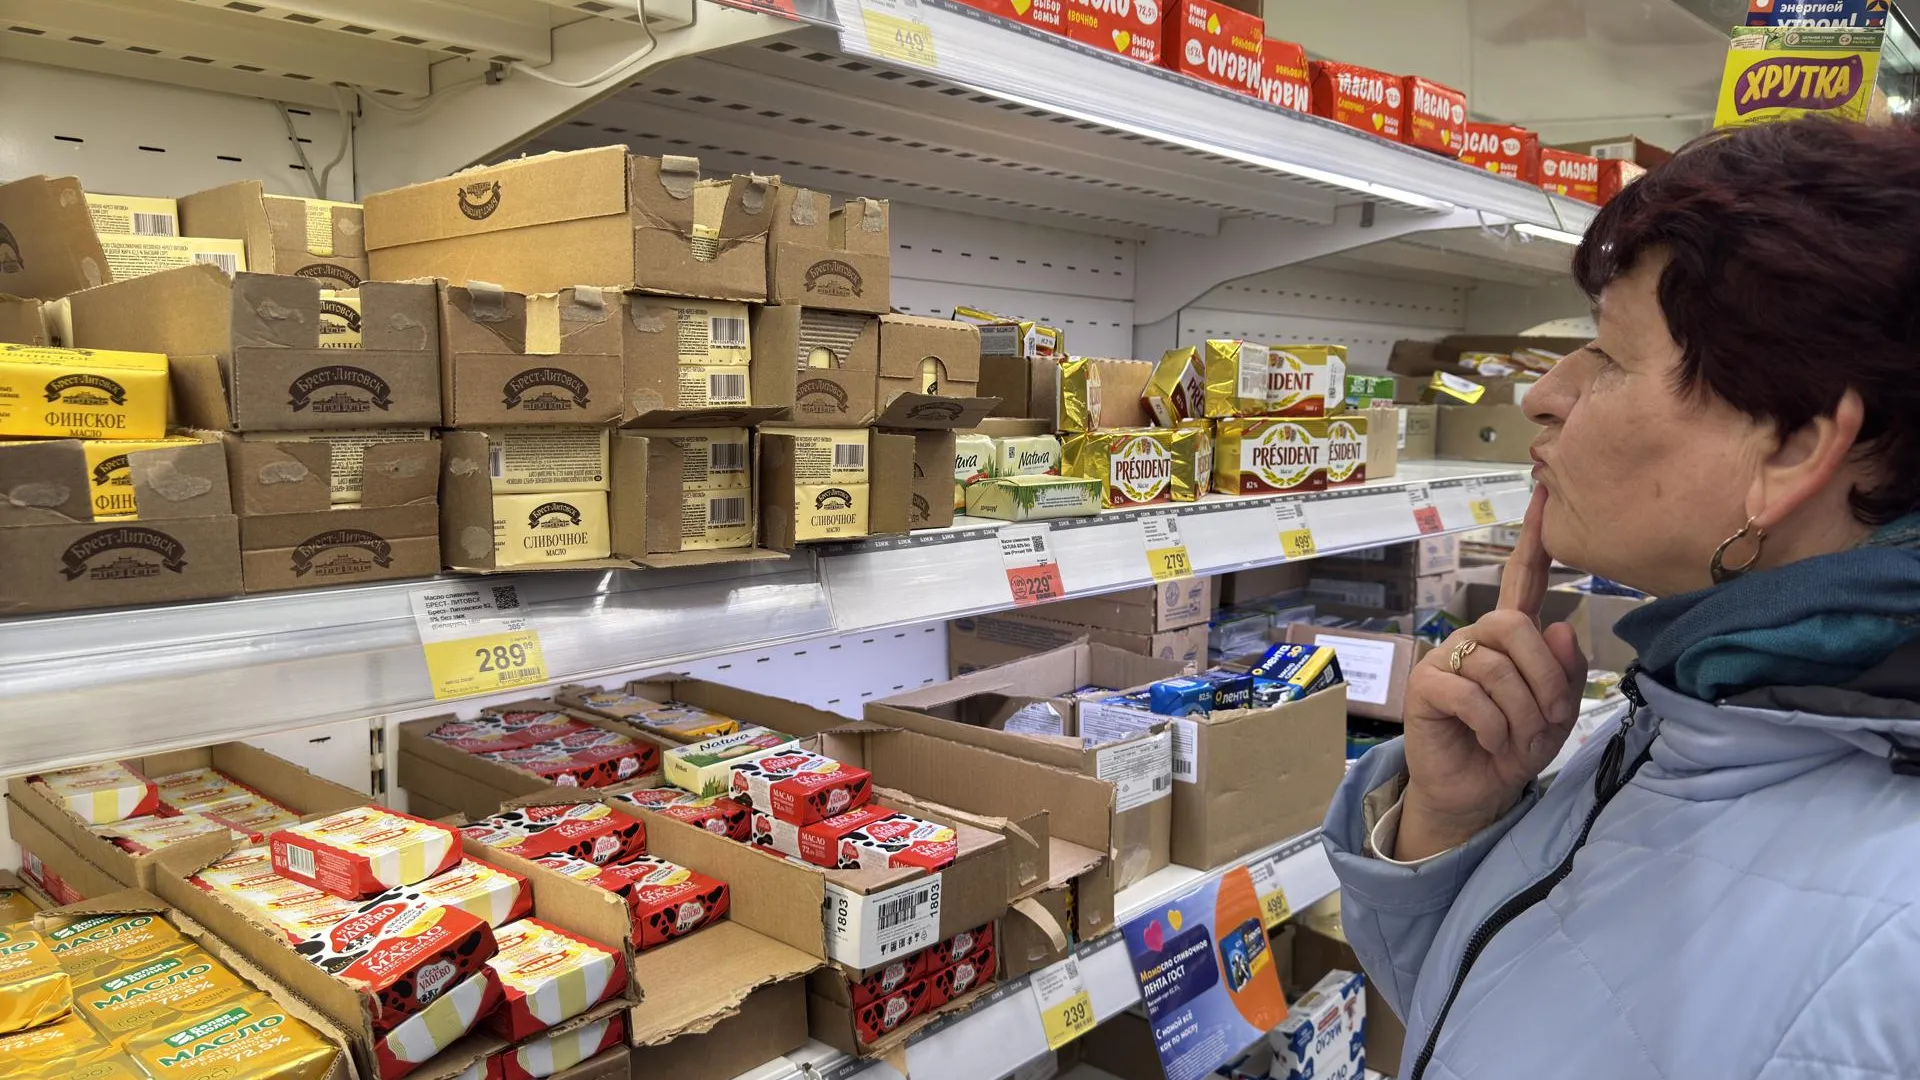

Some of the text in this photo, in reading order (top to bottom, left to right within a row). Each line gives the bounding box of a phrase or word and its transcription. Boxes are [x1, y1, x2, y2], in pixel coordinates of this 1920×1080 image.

[1780, 1, 1844, 19] энергией
[896, 28, 924, 52] 449
[1208, 46, 1261, 89] Масло
[1261, 77, 1309, 113] Масл
[1741, 64, 1850, 105] ХРУТКА
[1414, 87, 1450, 121] Масло
[799, 380, 845, 400] рест-Литовск
[45, 412, 126, 429] ФИНСКОЕ
[1018, 452, 1050, 469] Natura
[1253, 443, 1320, 469] PRÉSIDENT
[1116, 457, 1171, 484] PRÉSIDENT
[811, 514, 856, 527] СЛИВОЧНОЕ
[524, 532, 588, 549] СЛИВОЧНОЕ
[1295, 536, 1310, 549] 499
[1164, 553, 1184, 570] 279
[1027, 576, 1050, 595] 229
[475, 643, 527, 673] 289
[1262, 644, 1291, 671] лента
[1222, 690, 1250, 704] лента
[700, 732, 751, 752] Natura
[773, 789, 794, 803] МАСЛО
[801, 833, 825, 846] МАСЛО
[930, 883, 940, 918] 1803
[1268, 896, 1283, 914] 499
[336, 907, 396, 944] УДОЕВО
[837, 899, 849, 933] 1803
[368, 926, 443, 974] МАСЛО
[1173, 940, 1208, 964] сливочное
[93, 964, 212, 1010] МАСЛО
[418, 966, 452, 992] УДОЕВО
[1144, 964, 1185, 997] ЛЕНТА ГОСТ
[156, 981, 215, 1006] 72,5%
[1064, 1003, 1086, 1027] 239
[1156, 1029, 1162, 1040] С
[1162, 1016, 1182, 1037] мамой
[1171, 1034, 1180, 1046] по
[157, 1014, 285, 1068] МАСЛО
[180, 1027, 281, 1069] КРЕСТЬЯНСКОЕ
[228, 1035, 291, 1063] 72,5%
